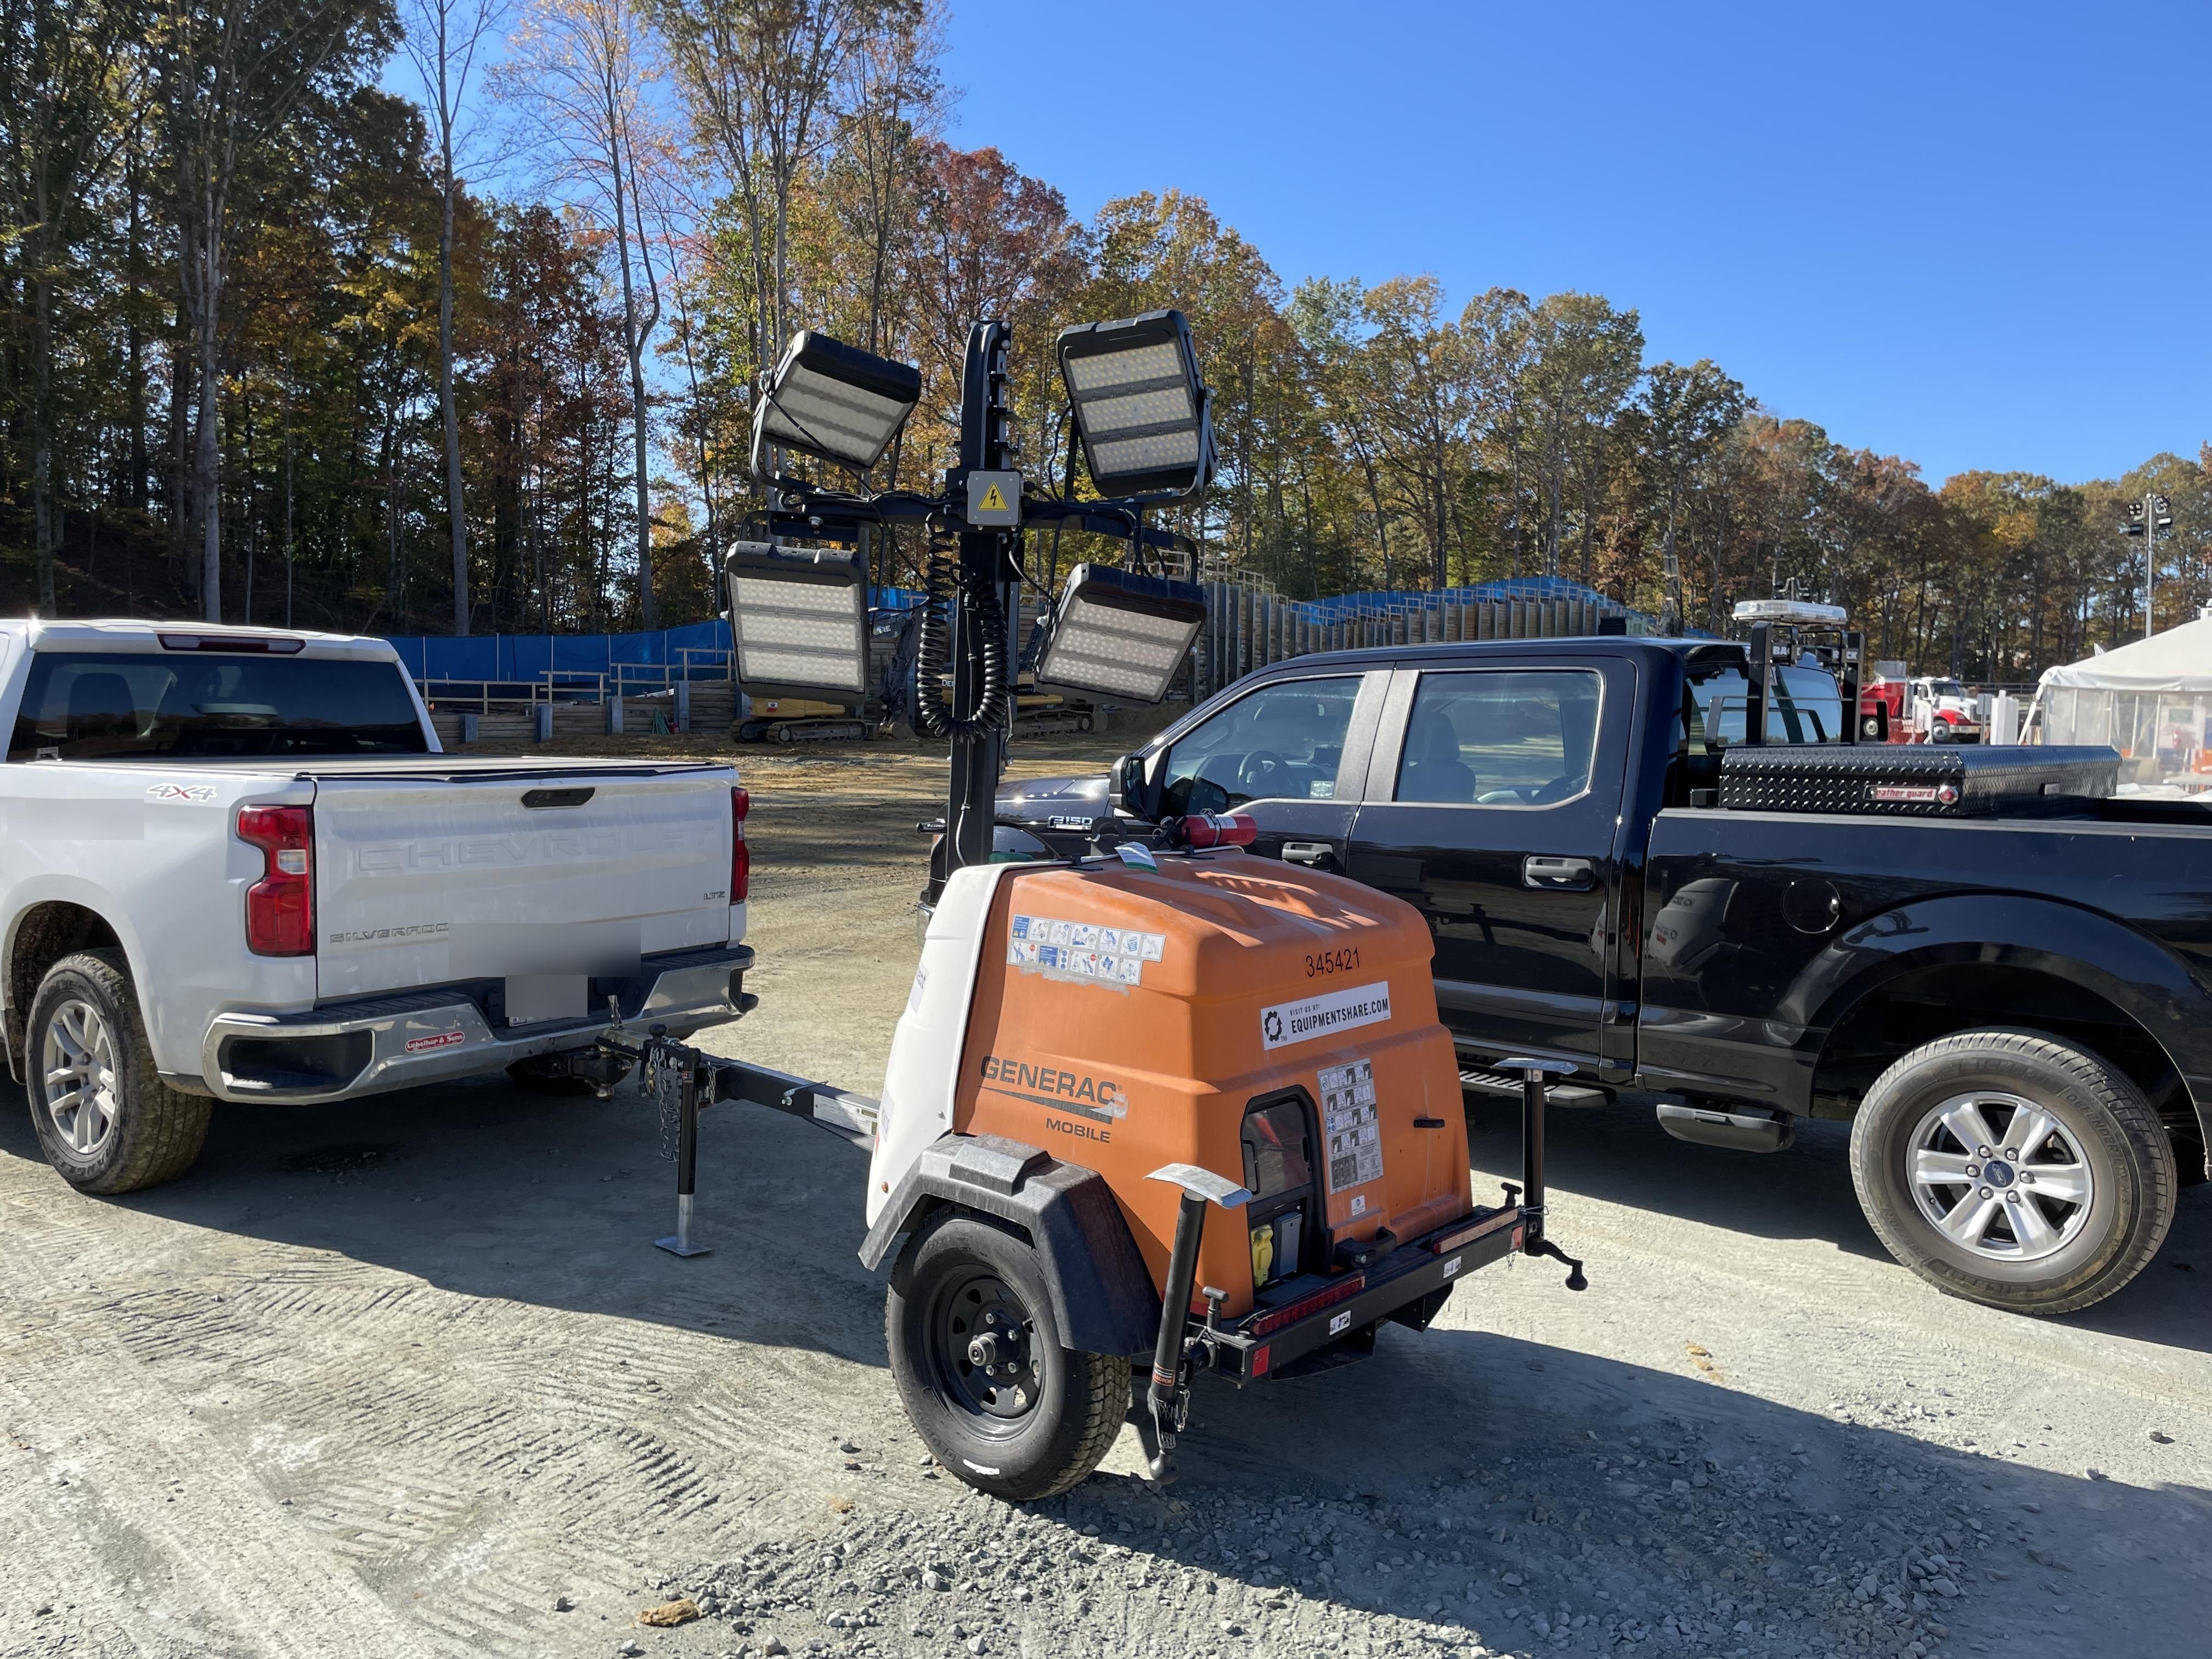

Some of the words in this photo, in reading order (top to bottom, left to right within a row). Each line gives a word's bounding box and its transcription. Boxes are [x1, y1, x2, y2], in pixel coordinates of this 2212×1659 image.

[1876, 788, 1905, 797] eather
[358, 825, 715, 871] CHEVROLET
[704, 891, 725, 900] LTZ
[330, 922, 449, 943] SILVERADO
[1306, 947, 1359, 977] 345421
[1290, 1007, 1303, 1016] VISIT
[1305, 1005, 1311, 1013] US
[1291, 998, 1389, 1034] EQUIPMENTSHARE.COM
[447, 1034, 463, 1042] Sons
[980, 1056, 1116, 1105] GENERAC
[1046, 1118, 1111, 1143] MOBILE
